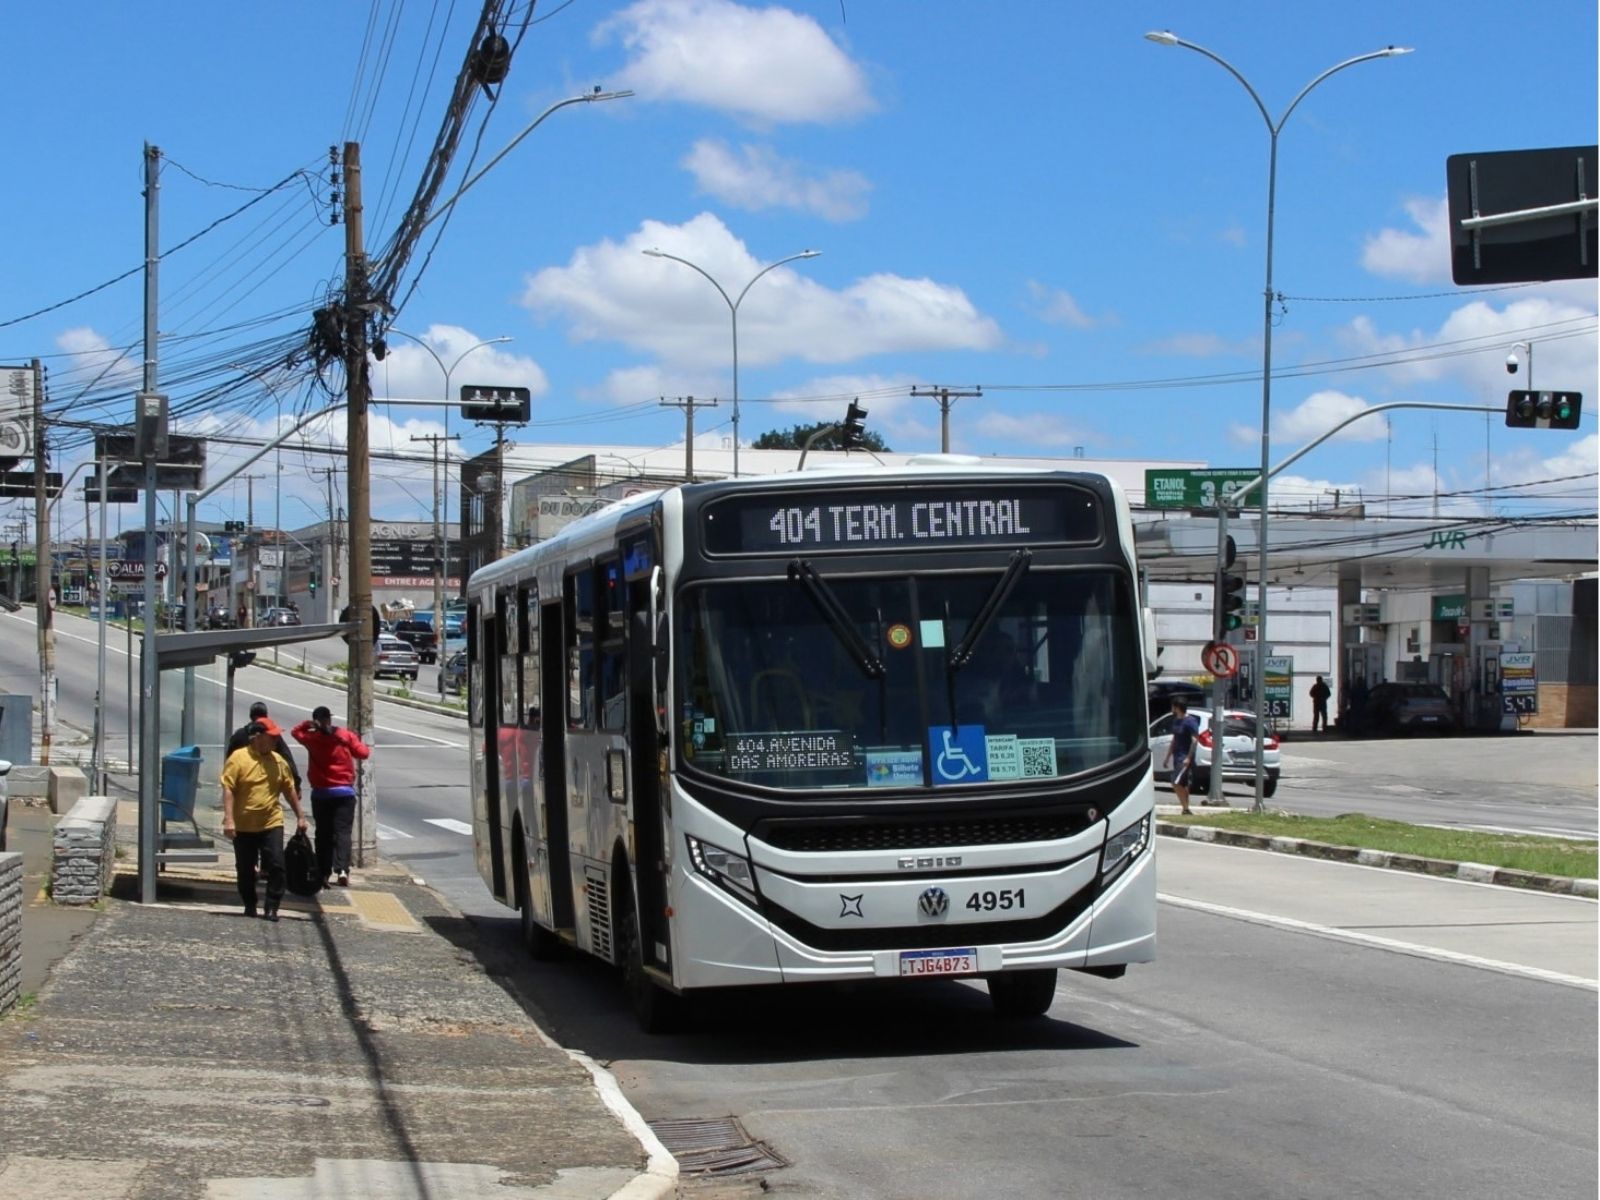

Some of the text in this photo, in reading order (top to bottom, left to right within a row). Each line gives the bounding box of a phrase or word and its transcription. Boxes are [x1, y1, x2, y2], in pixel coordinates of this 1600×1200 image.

[1153, 478, 1187, 491] ETANOL
[769, 499, 1031, 543] 404 TERM. CENTRAL
[1423, 531, 1466, 550] JVR
[121, 563, 166, 574] ALIAA
[1264, 686, 1290, 695] tanol
[1504, 696, 1535, 713] 5,47
[730, 752, 851, 770] DAS AMOREIRAS
[965, 888, 1026, 912] 4951
[908, 956, 970, 974] TJG4B73
